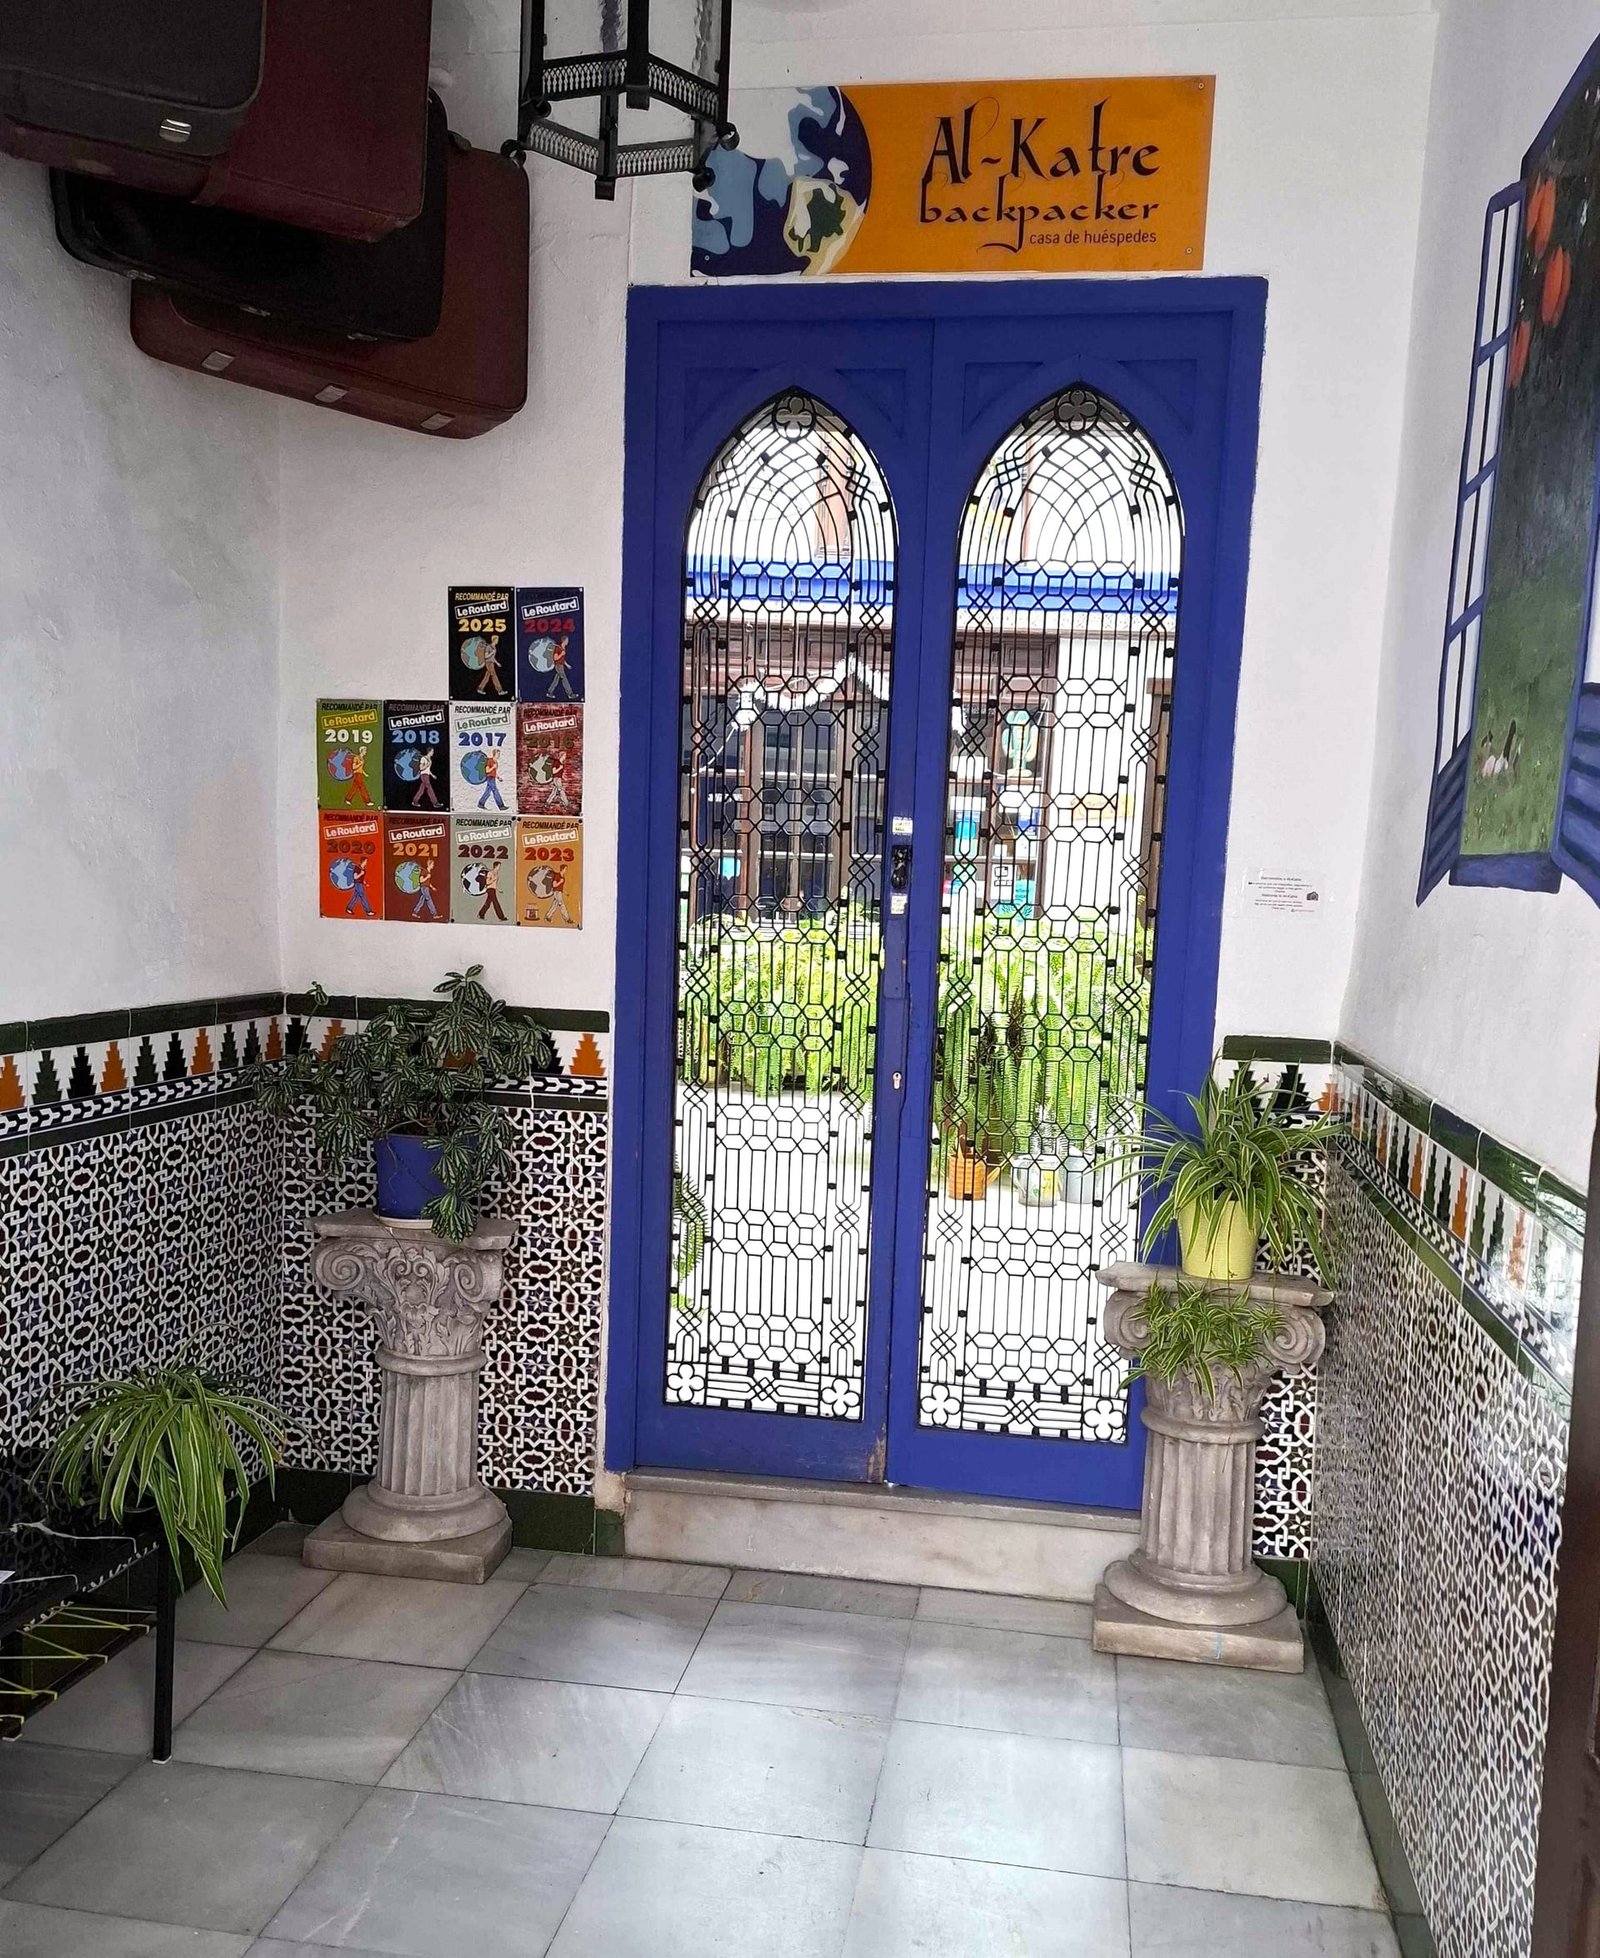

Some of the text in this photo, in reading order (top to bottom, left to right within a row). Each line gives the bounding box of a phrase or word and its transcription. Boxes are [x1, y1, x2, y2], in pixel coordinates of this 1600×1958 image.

[922, 96, 1160, 184] Al-Katre
[919, 172, 1160, 254] backpacker
[1029, 229, 1157, 247] casa de huéspedes
[458, 618, 507, 632] 2025
[524, 618, 575, 633] 2024
[455, 705, 511, 714] RECOMMANDÉ PAR
[324, 729, 373, 744] 2019
[392, 729, 440, 744] 2018
[458, 732, 507, 747] 2017
[526, 734, 575, 750] 2016
[456, 818, 499, 828] RECOMMANDÉ
[499, 820, 512, 828] PAR
[522, 821, 566, 830] RECOMMANDÉ
[327, 840, 376, 855] 2020
[393, 842, 438, 857] 2021
[458, 844, 509, 860] 2022
[524, 846, 575, 862] 2023
